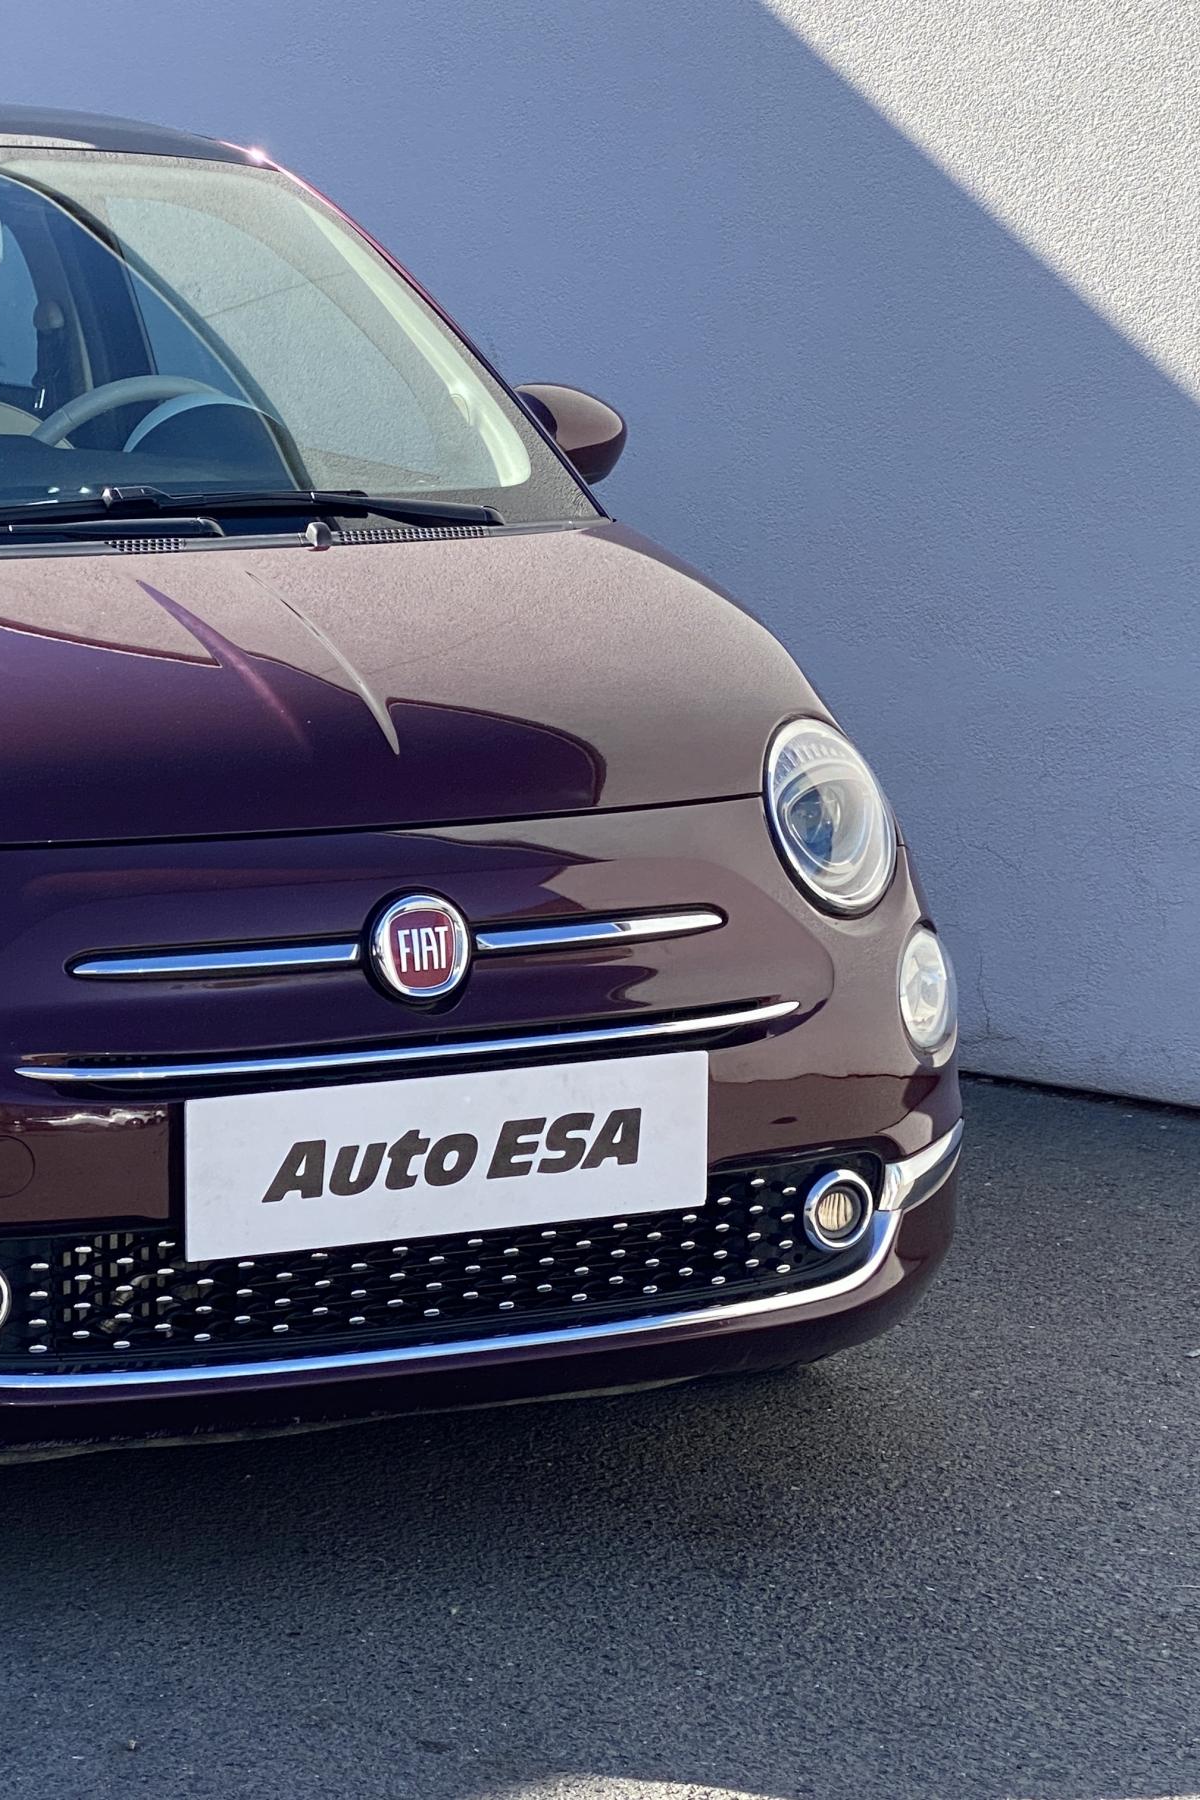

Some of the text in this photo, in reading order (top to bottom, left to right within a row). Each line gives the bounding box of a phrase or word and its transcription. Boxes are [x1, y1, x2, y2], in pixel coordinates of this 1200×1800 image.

[397, 925, 449, 973] FIAT
[261, 1107, 642, 1204] Auto ESA
